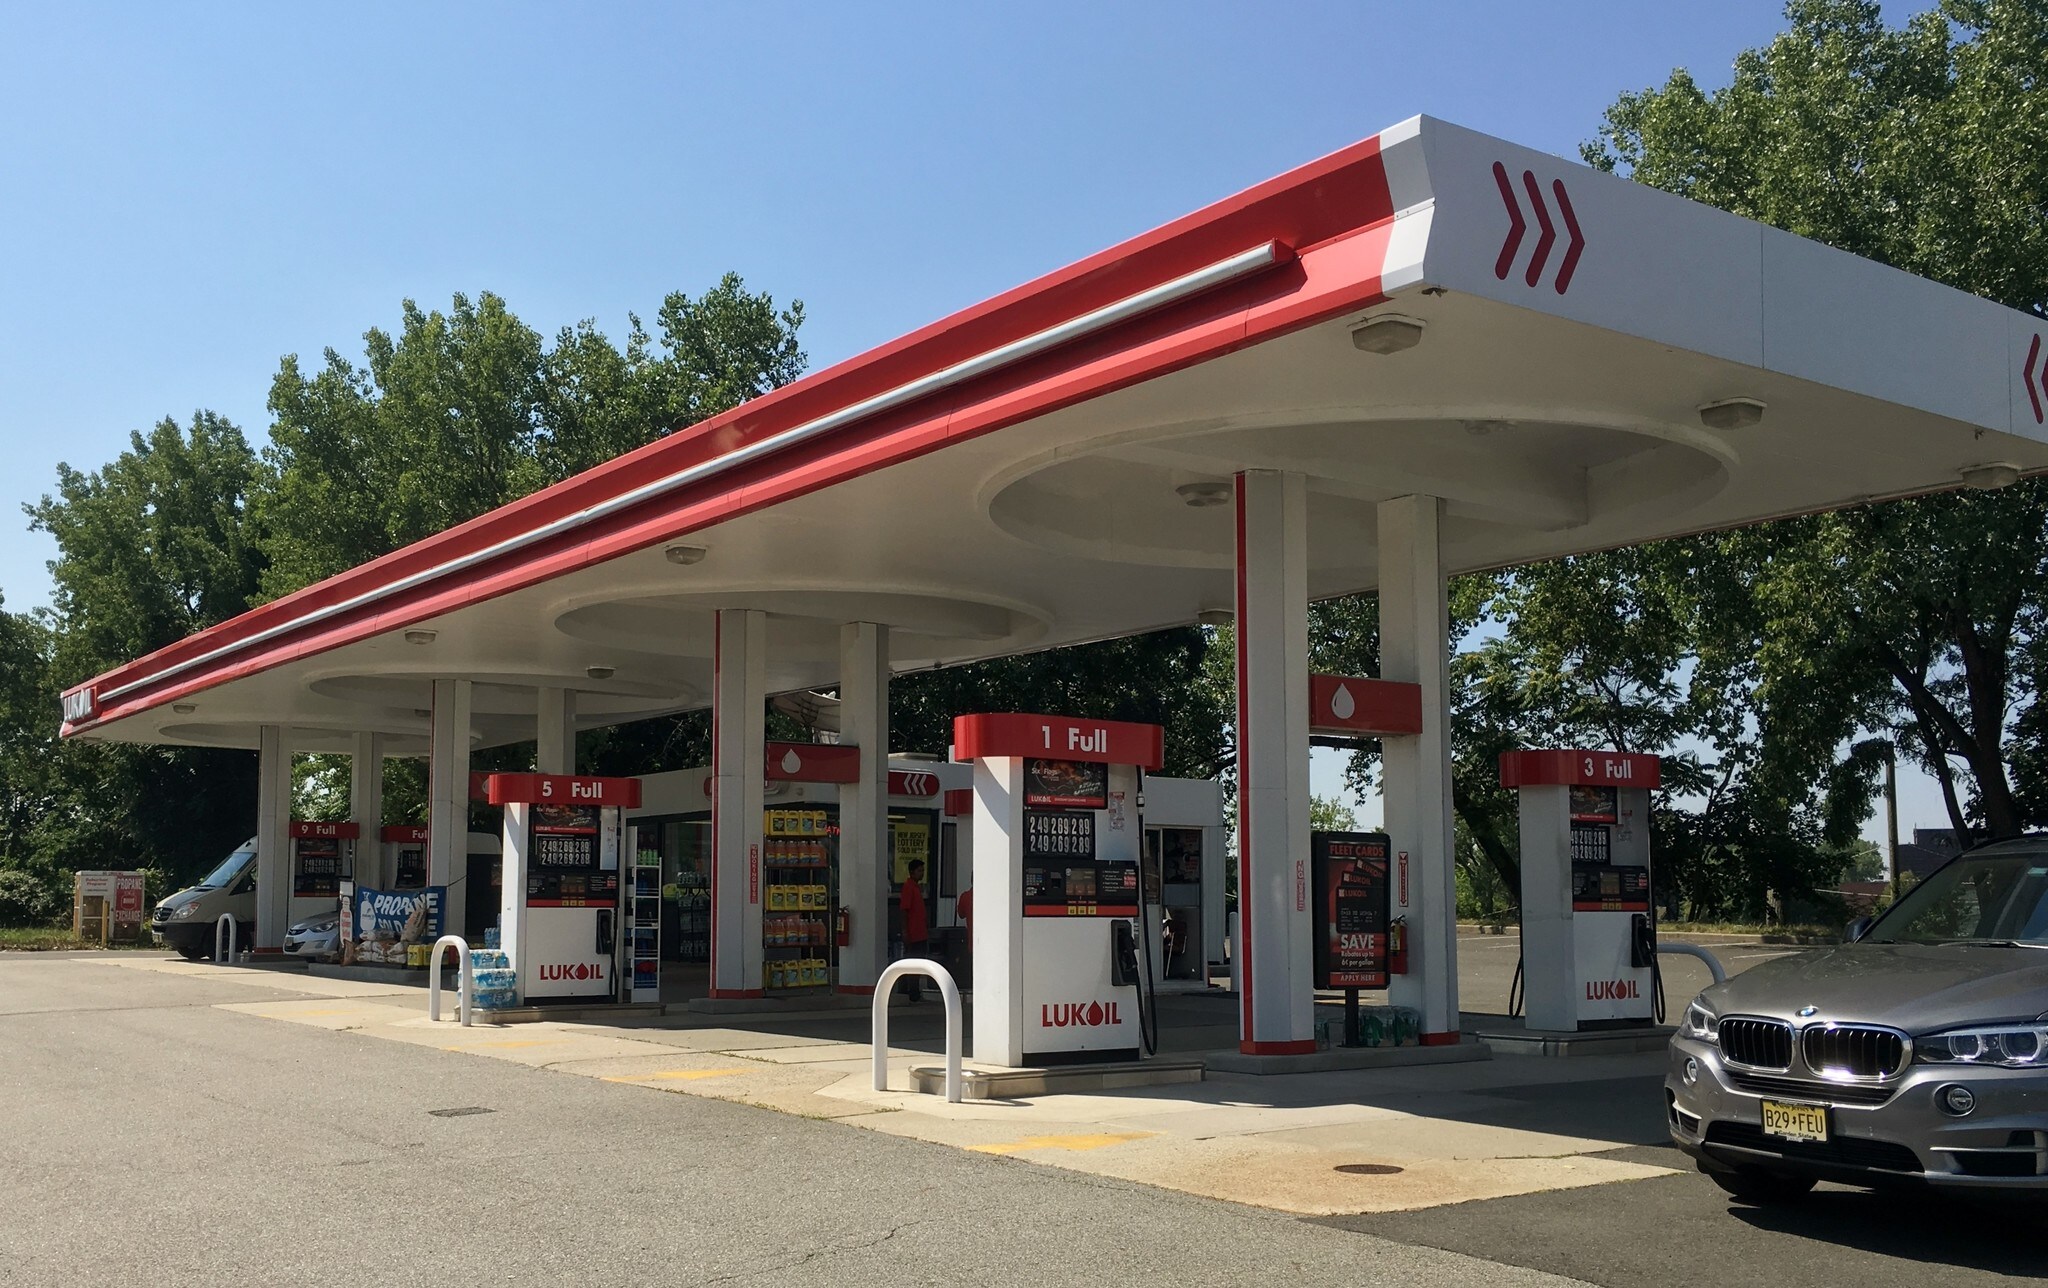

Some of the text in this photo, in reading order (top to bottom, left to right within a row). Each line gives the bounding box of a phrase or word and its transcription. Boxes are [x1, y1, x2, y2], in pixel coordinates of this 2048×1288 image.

[1042, 725, 1107, 753] 1 Full
[1584, 757, 1632, 779] 3 Full
[542, 780, 603, 798] 5 Full
[1031, 795, 1052, 803] LUKOIL
[301, 824, 336, 835] 9 Full
[412, 829, 427, 839] Ful
[897, 838, 925, 847] LOTTERY
[1329, 844, 1385, 857] FLEET CARDS
[117, 878, 143, 889] PROPANE
[1350, 875, 1371, 886] LUKOIL
[1345, 889, 1367, 897] LUKOIL
[1341, 934, 1375, 950] SAVE
[1358, 959, 1374, 967] gallon
[540, 962, 604, 981] LUKOIL
[1587, 978, 1640, 1000] LUKOIL
[1042, 1000, 1122, 1027] LUKOIL
[1765, 1109, 1824, 1134] B29 FEU
